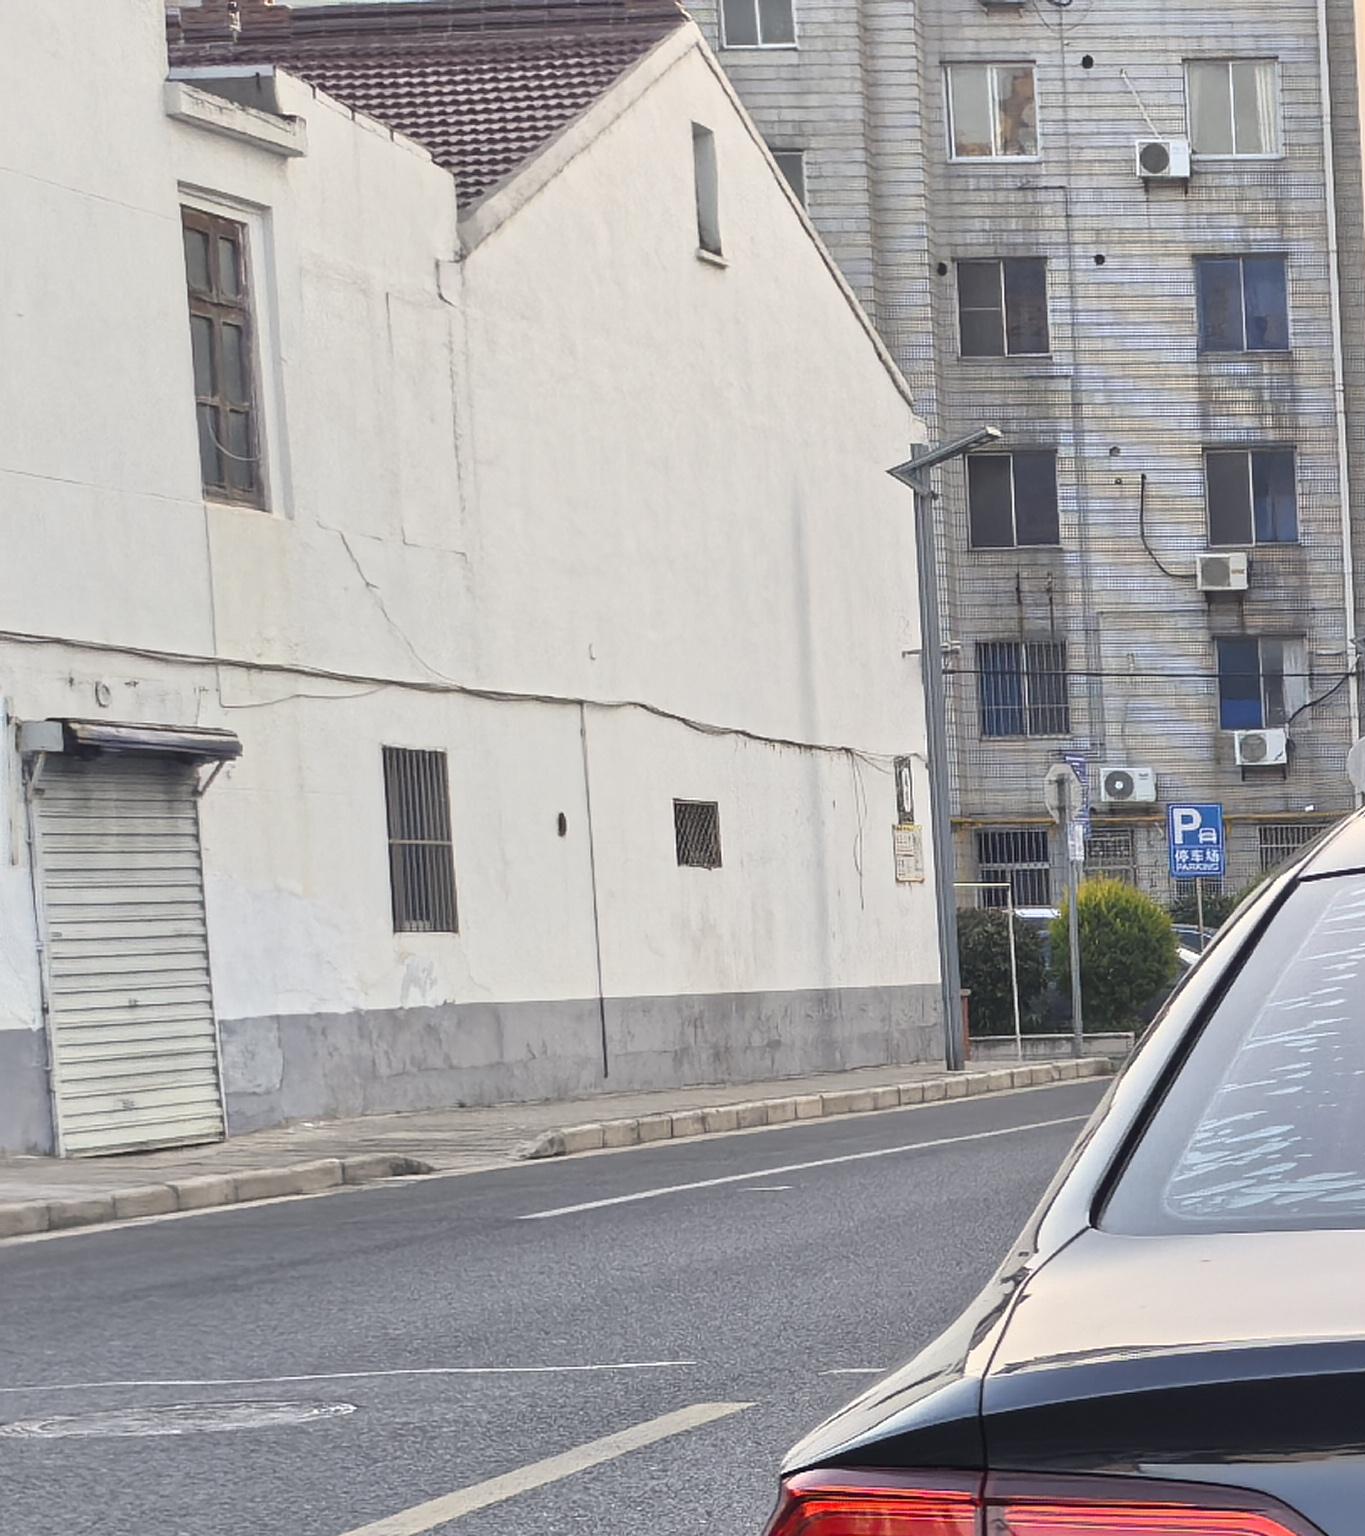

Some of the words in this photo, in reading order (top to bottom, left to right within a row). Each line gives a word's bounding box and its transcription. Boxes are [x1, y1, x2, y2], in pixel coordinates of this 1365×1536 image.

[1173, 808, 1202, 845] P
[1175, 848, 1219, 863] 停车场
[1176, 862, 1219, 872] PARKING
